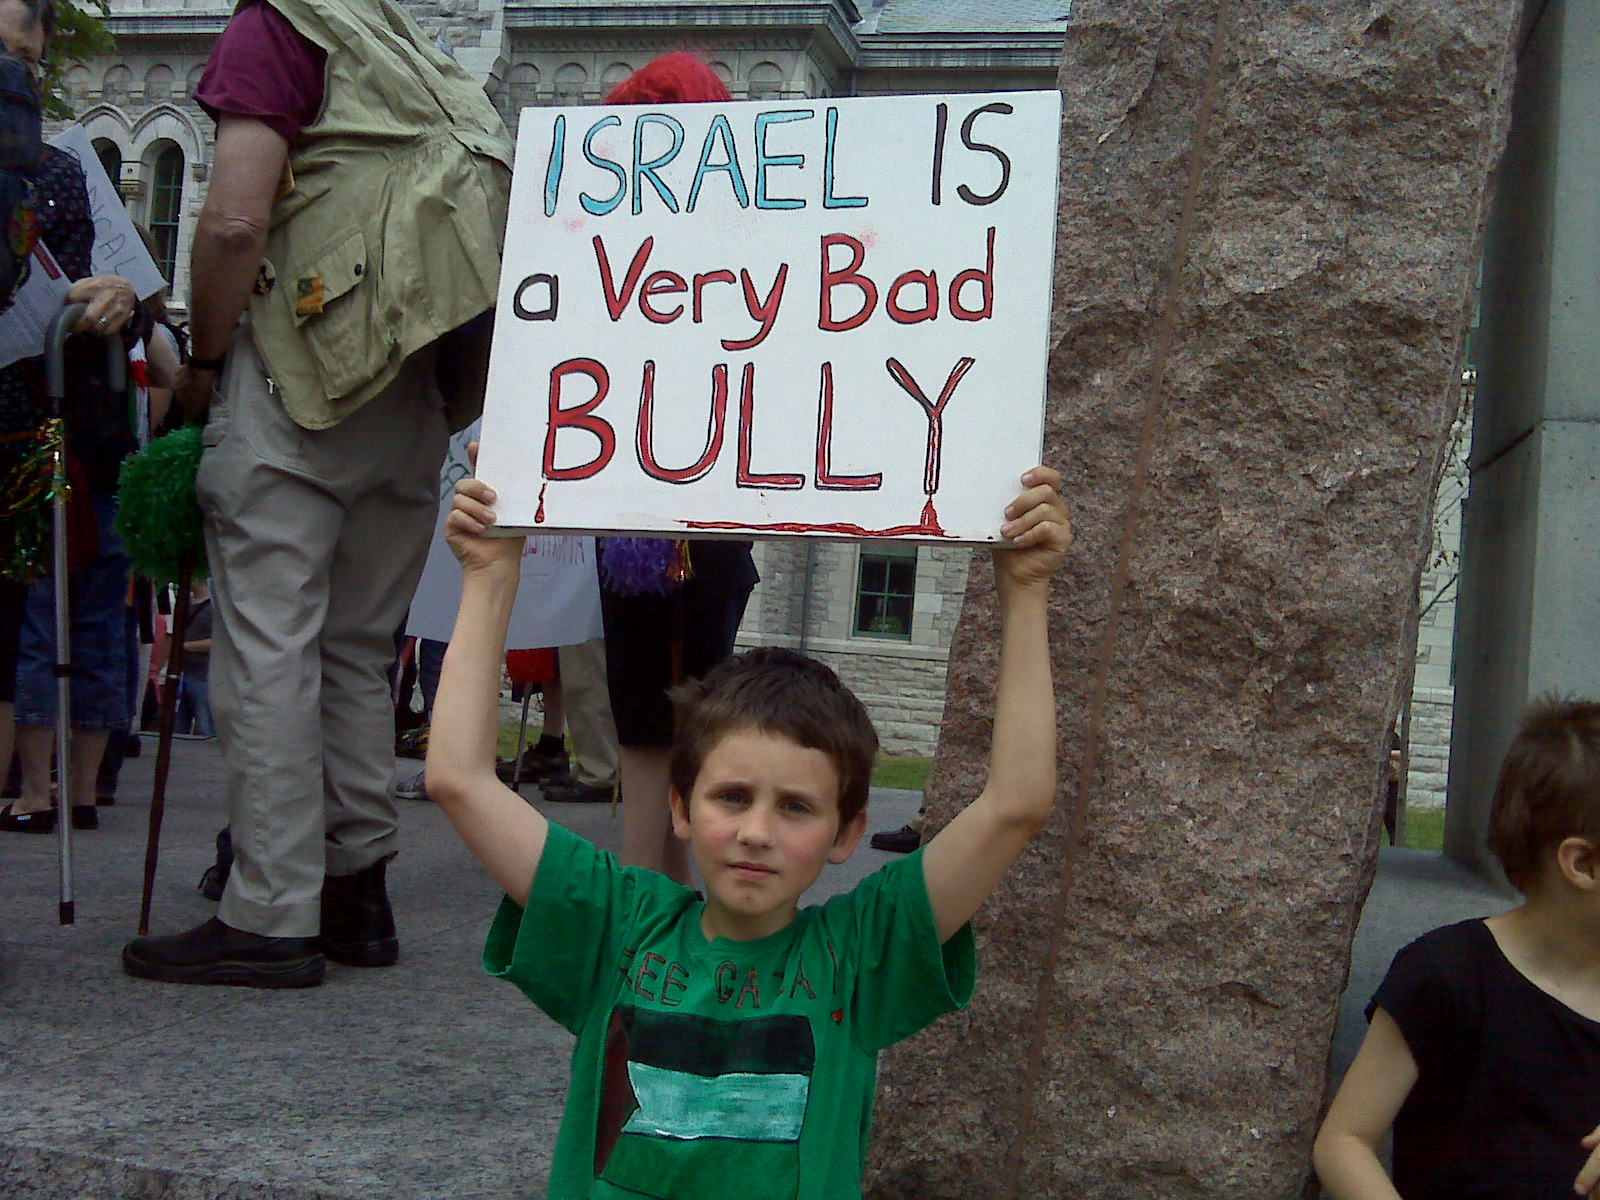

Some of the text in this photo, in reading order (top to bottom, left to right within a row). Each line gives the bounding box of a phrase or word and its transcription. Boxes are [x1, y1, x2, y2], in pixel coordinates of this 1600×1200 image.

[543, 102, 1014, 217] ISRAEL IS
[512, 226, 996, 351] a Very Bad
[541, 357, 976, 495] BULLY
